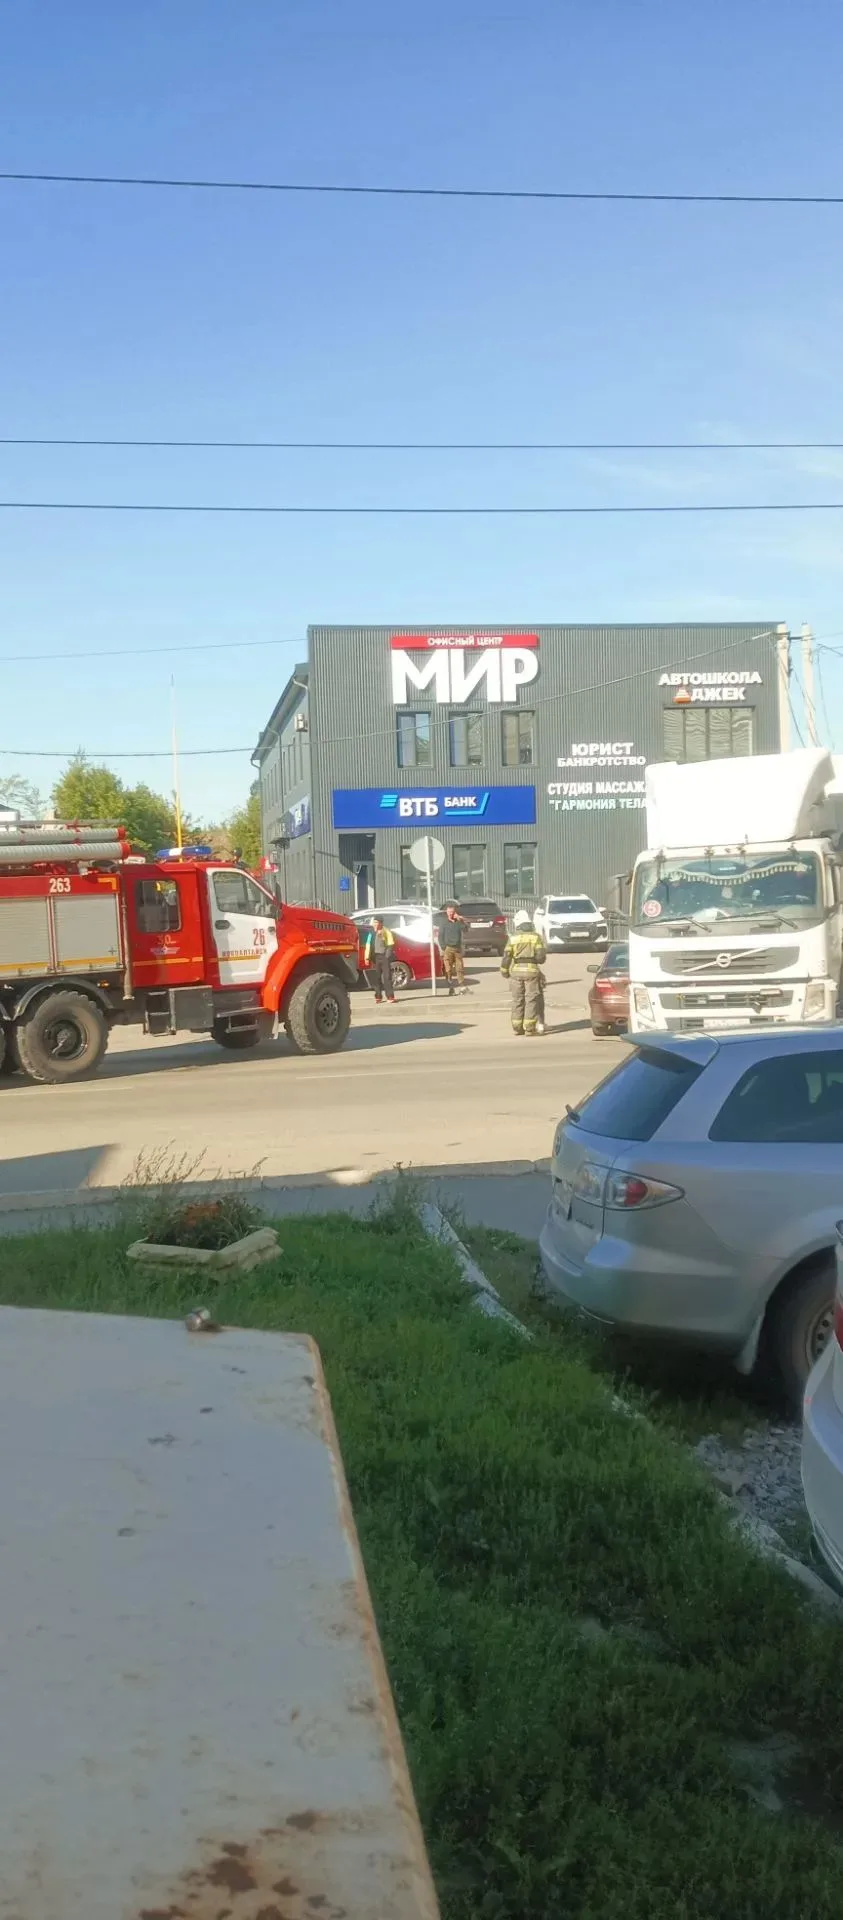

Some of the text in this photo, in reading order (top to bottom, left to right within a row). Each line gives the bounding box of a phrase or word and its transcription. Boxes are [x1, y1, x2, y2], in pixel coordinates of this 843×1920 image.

[427, 635, 504, 646] ОФИСНЫЙ ЦЕНТР
[391, 647, 538, 704] МИР
[658, 671, 763, 685] АВТОШКОЛА
[690, 687, 746, 701] ДЖЕК
[571, 742, 634, 756] ЮРИСТ
[557, 755, 646, 767] БАНКРОТСТВО
[547, 781, 648, 796] СТУДИЯ МАССАЖ
[399, 796, 477, 817] ВТБ БАНК
[549, 798, 617, 811] "ГАРМОНИЯ
[49, 877, 71, 893] 263
[252, 928, 266, 946] 26
